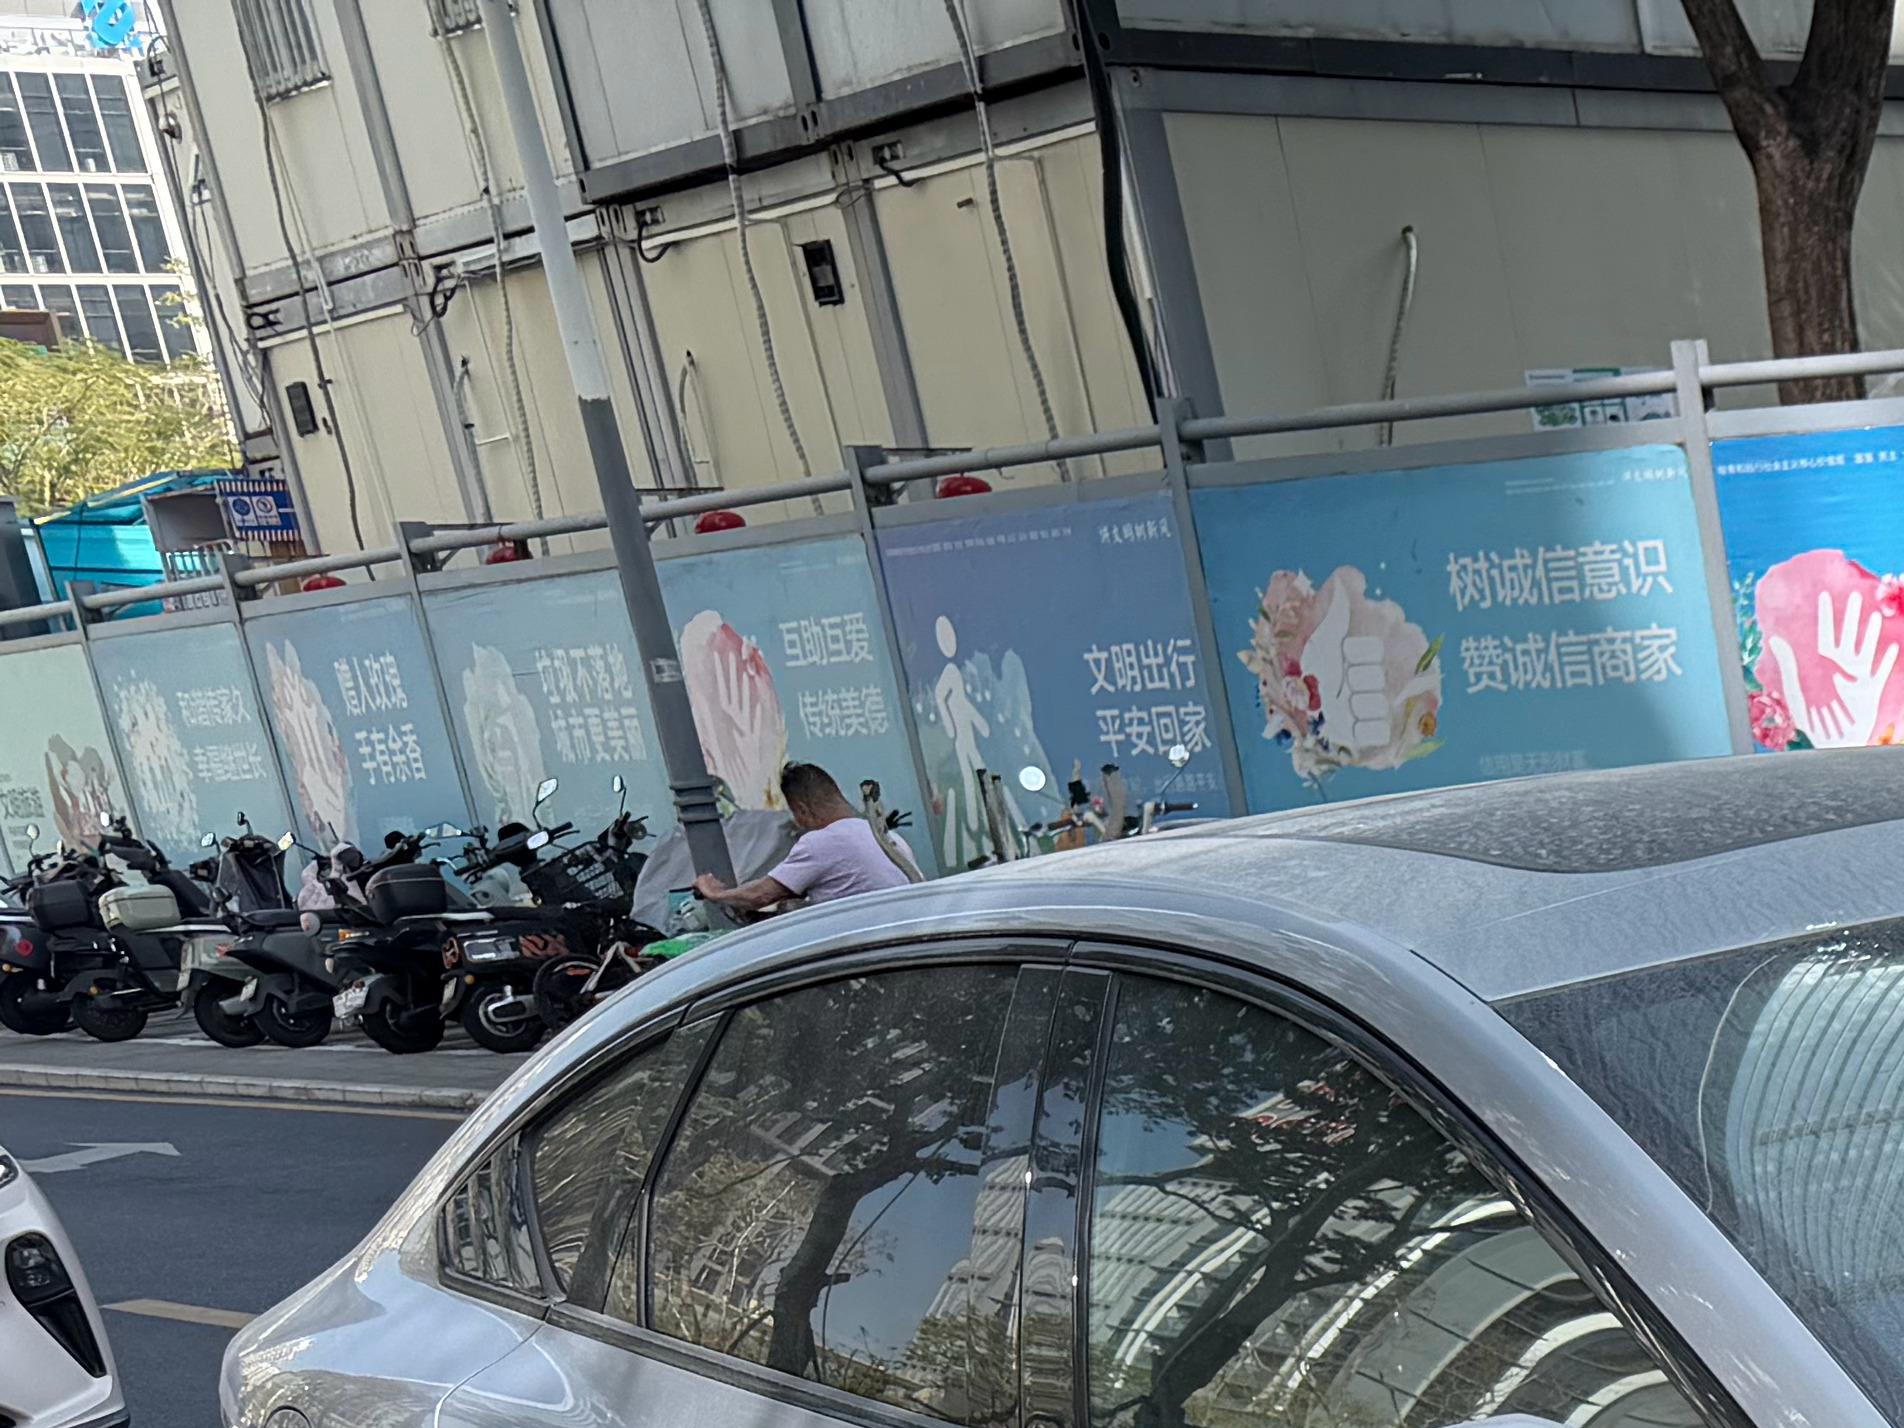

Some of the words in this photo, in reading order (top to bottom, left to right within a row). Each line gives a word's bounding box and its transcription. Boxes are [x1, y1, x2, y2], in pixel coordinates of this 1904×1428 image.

[1446, 538, 1674, 613] 树诚信意识
[777, 611, 876, 667] 互助互爱
[1083, 637, 1197, 696] 文明出行
[1459, 622, 1684, 695] 赞诚信商家
[797, 684, 890, 738] 传统美德
[1095, 703, 1213, 758] 平安回家
[354, 722, 428, 786] 手有余香
